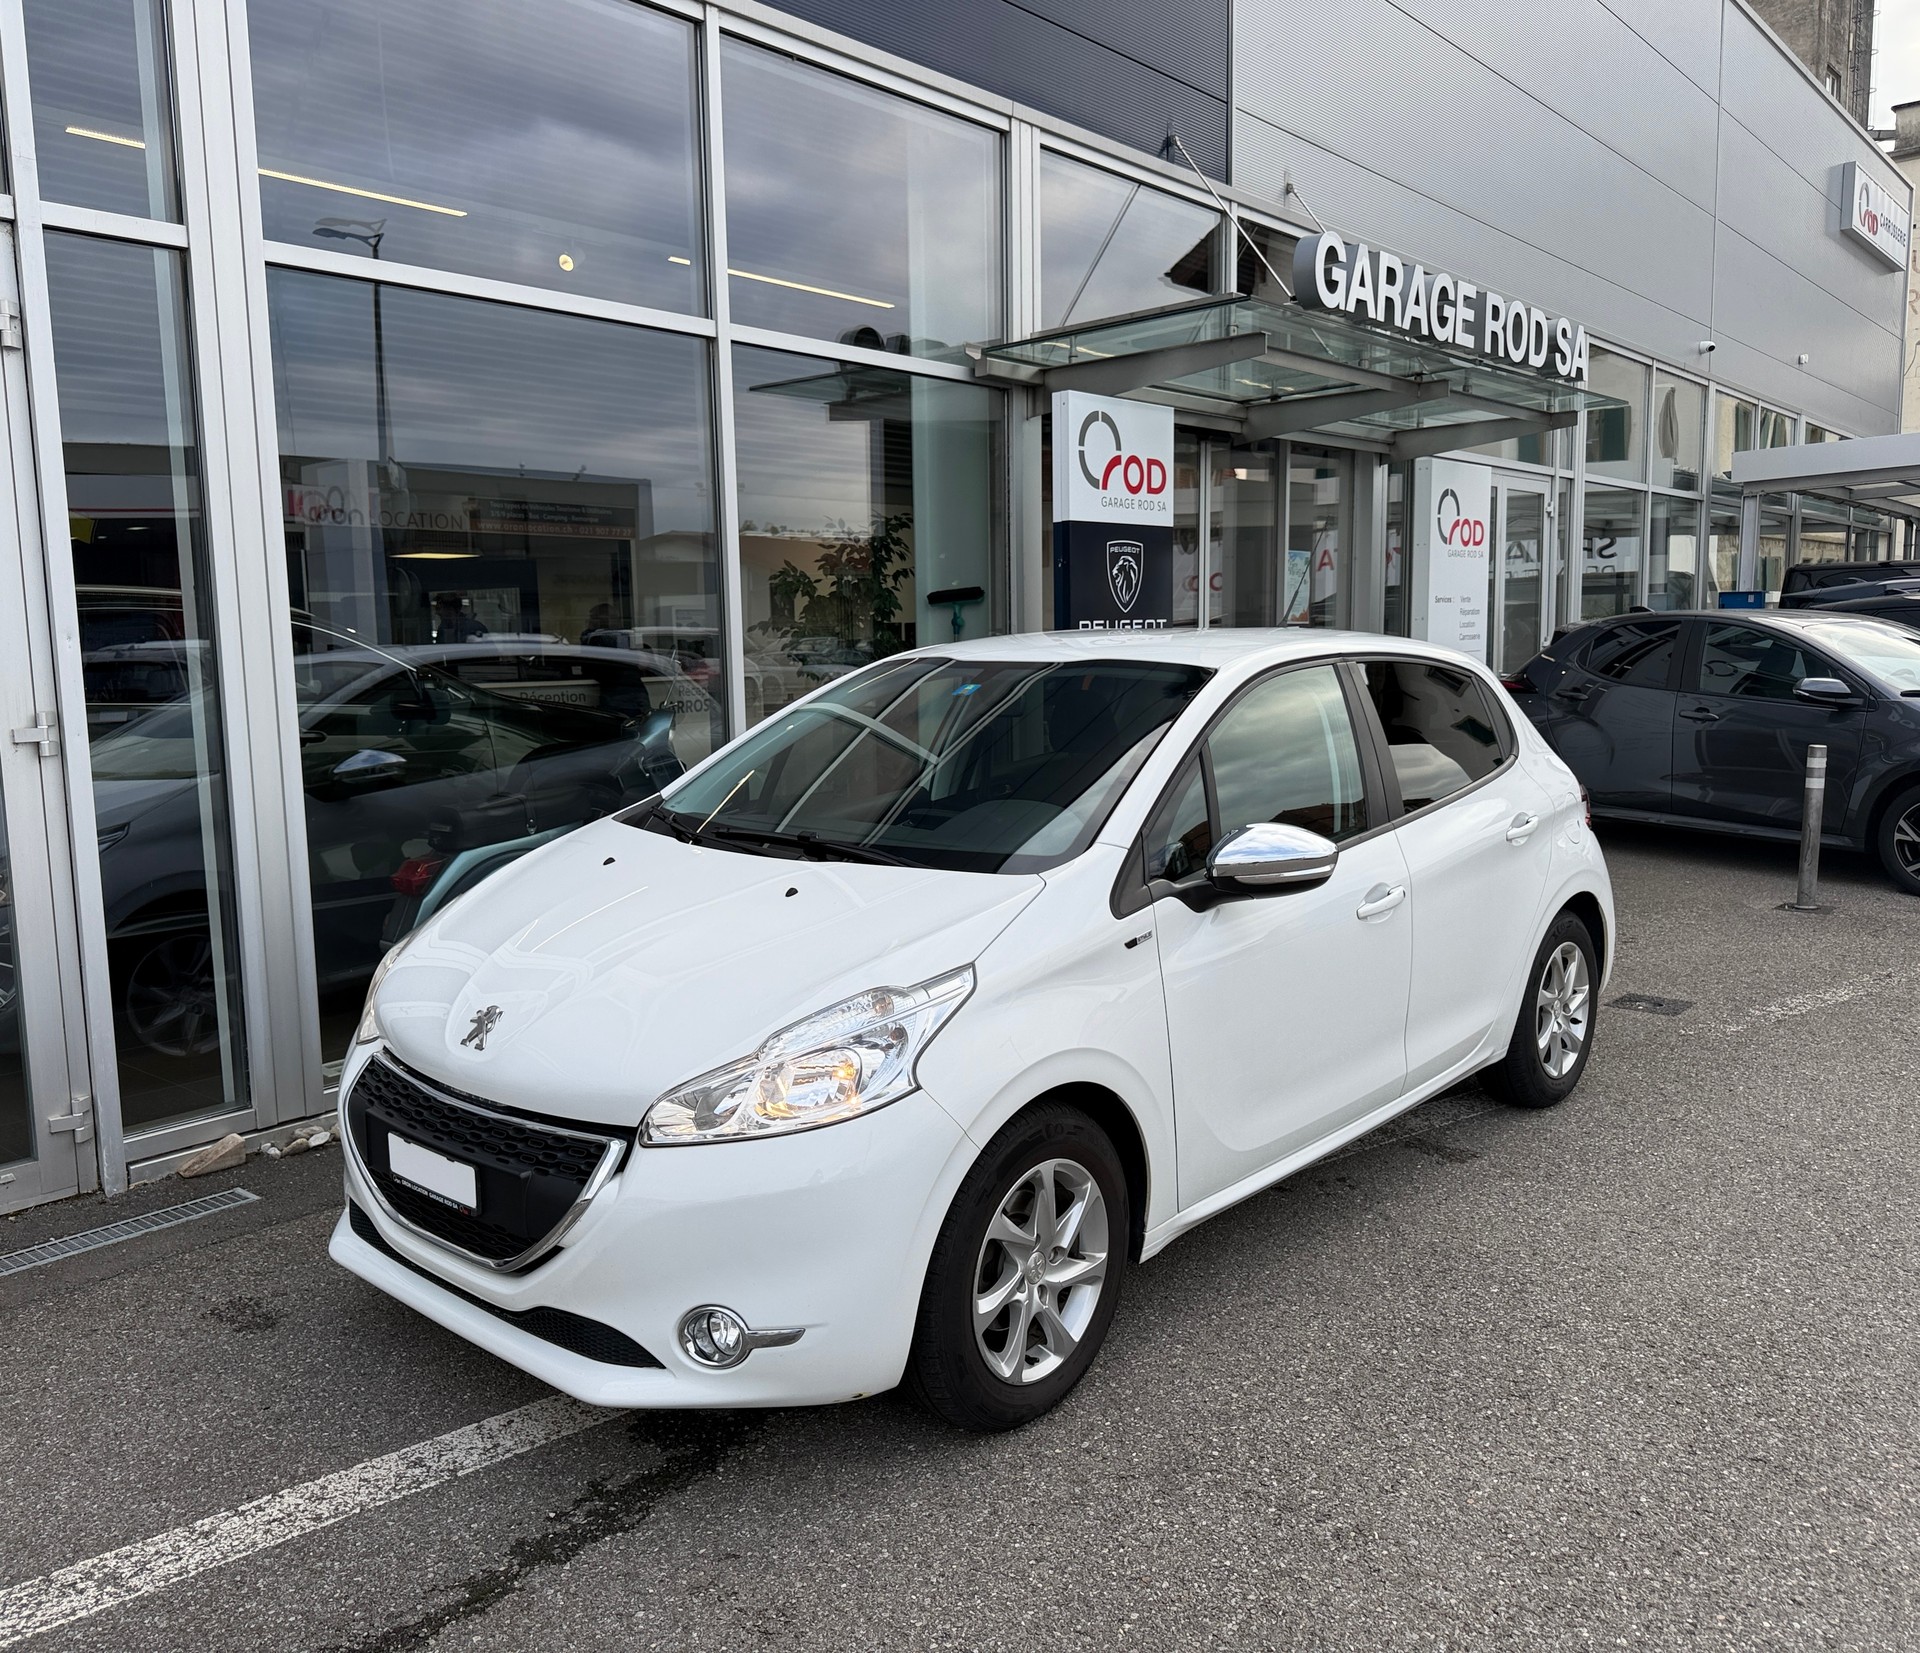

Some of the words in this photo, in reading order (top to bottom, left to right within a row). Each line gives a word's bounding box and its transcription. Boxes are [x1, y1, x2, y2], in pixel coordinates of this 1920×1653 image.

[1880, 212, 1906, 247] CARROSSERIE
[1315, 231, 1477, 348] GARAGE
[1484, 291, 1548, 368] ROD
[1555, 317, 1589, 382] SA
[1101, 496, 1135, 509] GARAGE
[1138, 499, 1154, 511] ROD
[1157, 501, 1167, 512] SA
[1110, 546, 1140, 554] PEUGEOT
[1447, 549, 1466, 558] GARAGE
[1467, 550, 1477, 558] ROD
[411, 1184, 428, 1197] LOCATION
[428, 1191, 444, 1204] GARAGE
